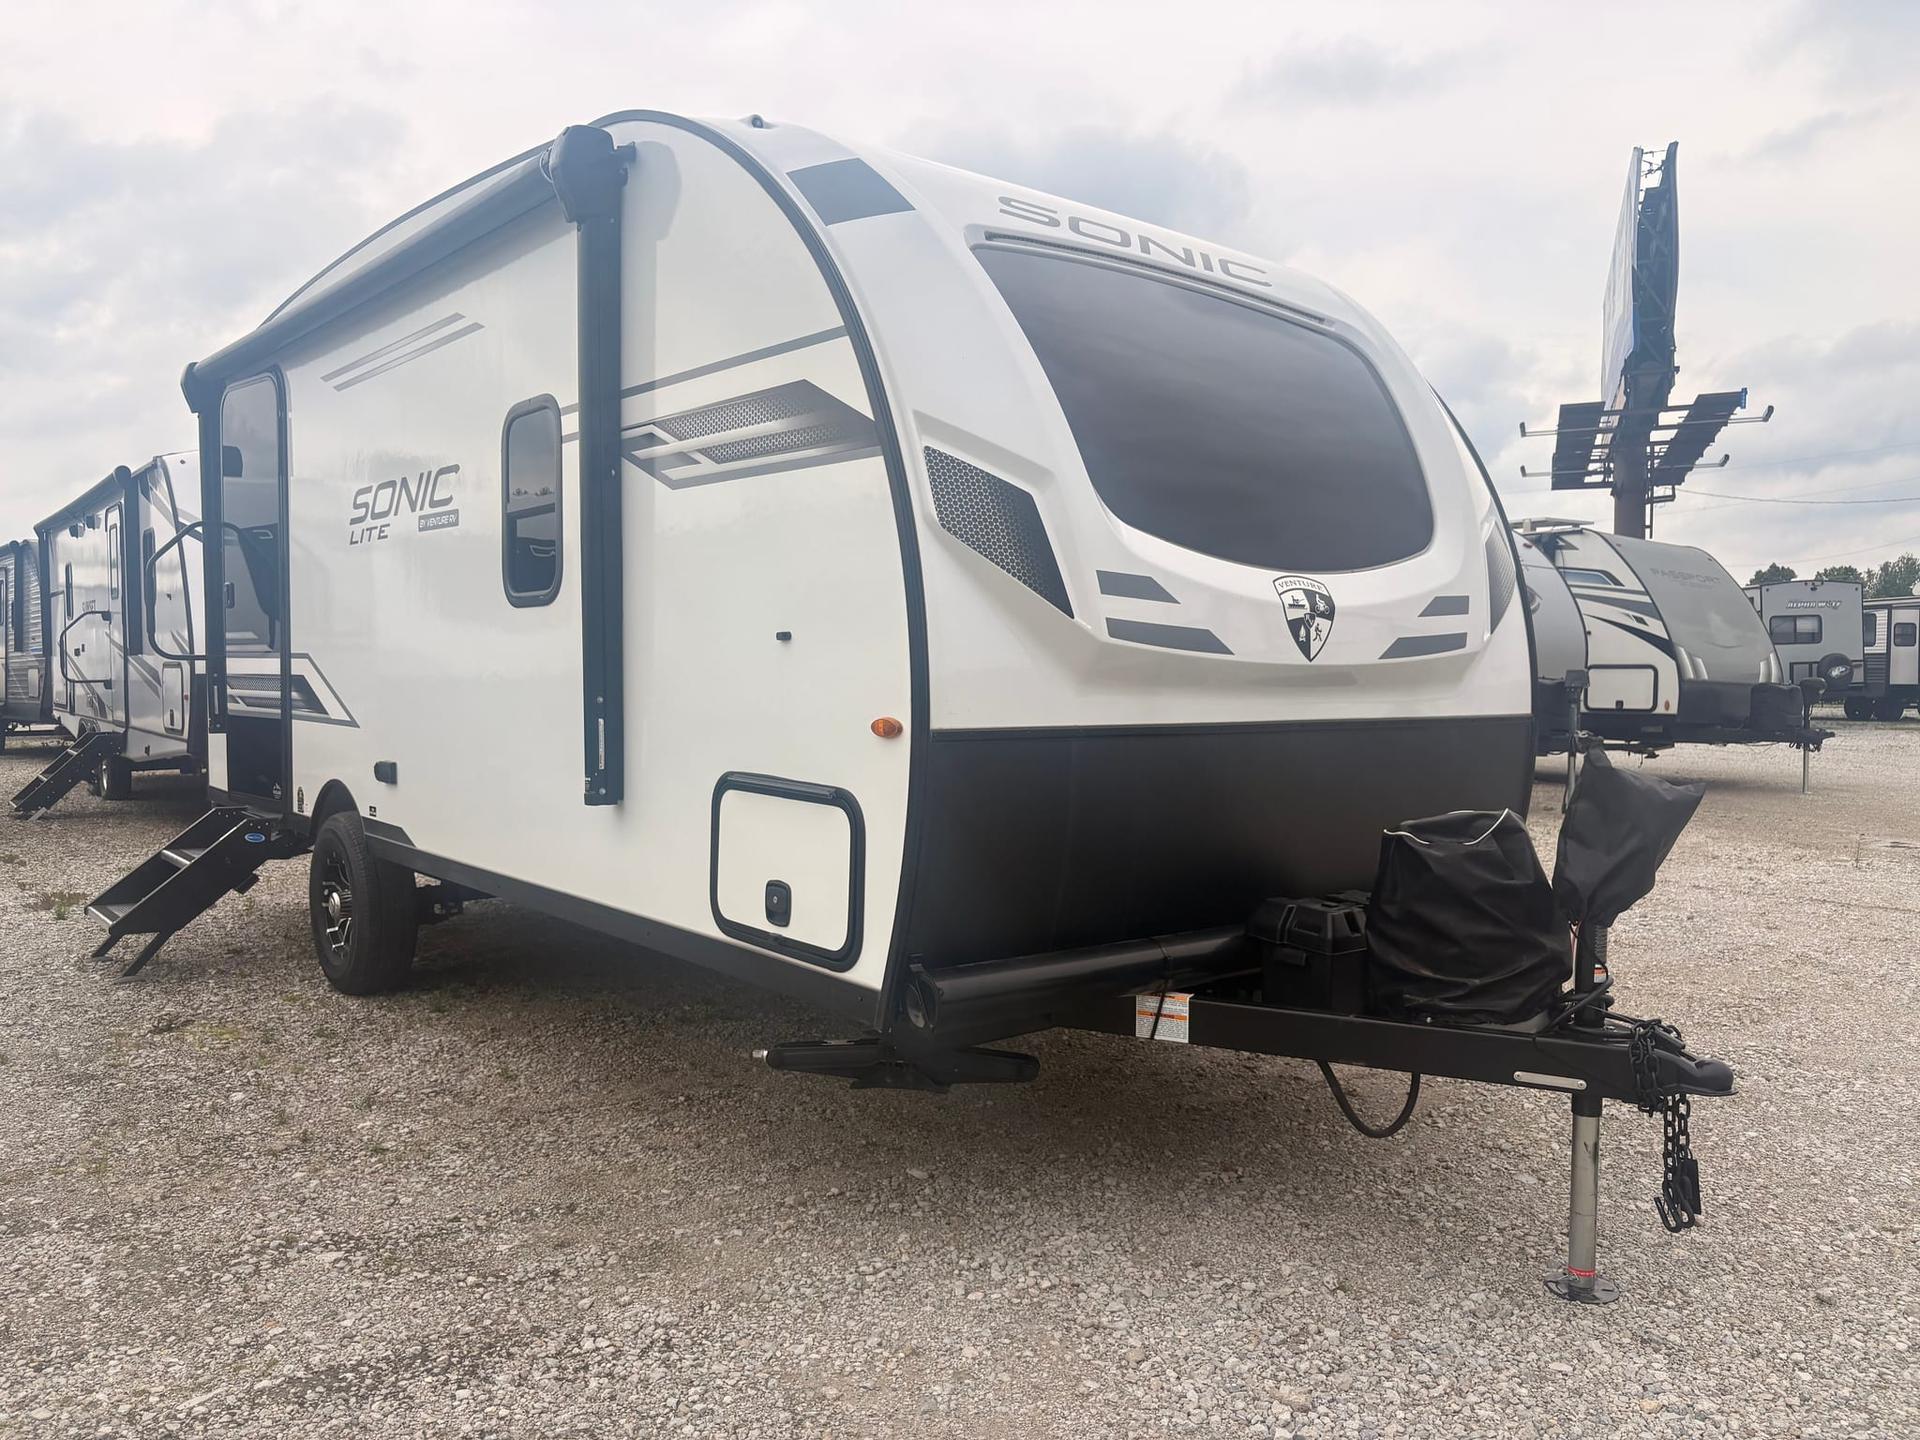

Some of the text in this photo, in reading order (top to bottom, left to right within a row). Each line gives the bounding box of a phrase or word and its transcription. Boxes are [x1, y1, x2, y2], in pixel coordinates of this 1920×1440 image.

[998, 196, 1273, 287] SONIC
[349, 464, 460, 526] SONIC
[349, 524, 391, 545] LITE
[1278, 579, 1324, 591] VENTURE
